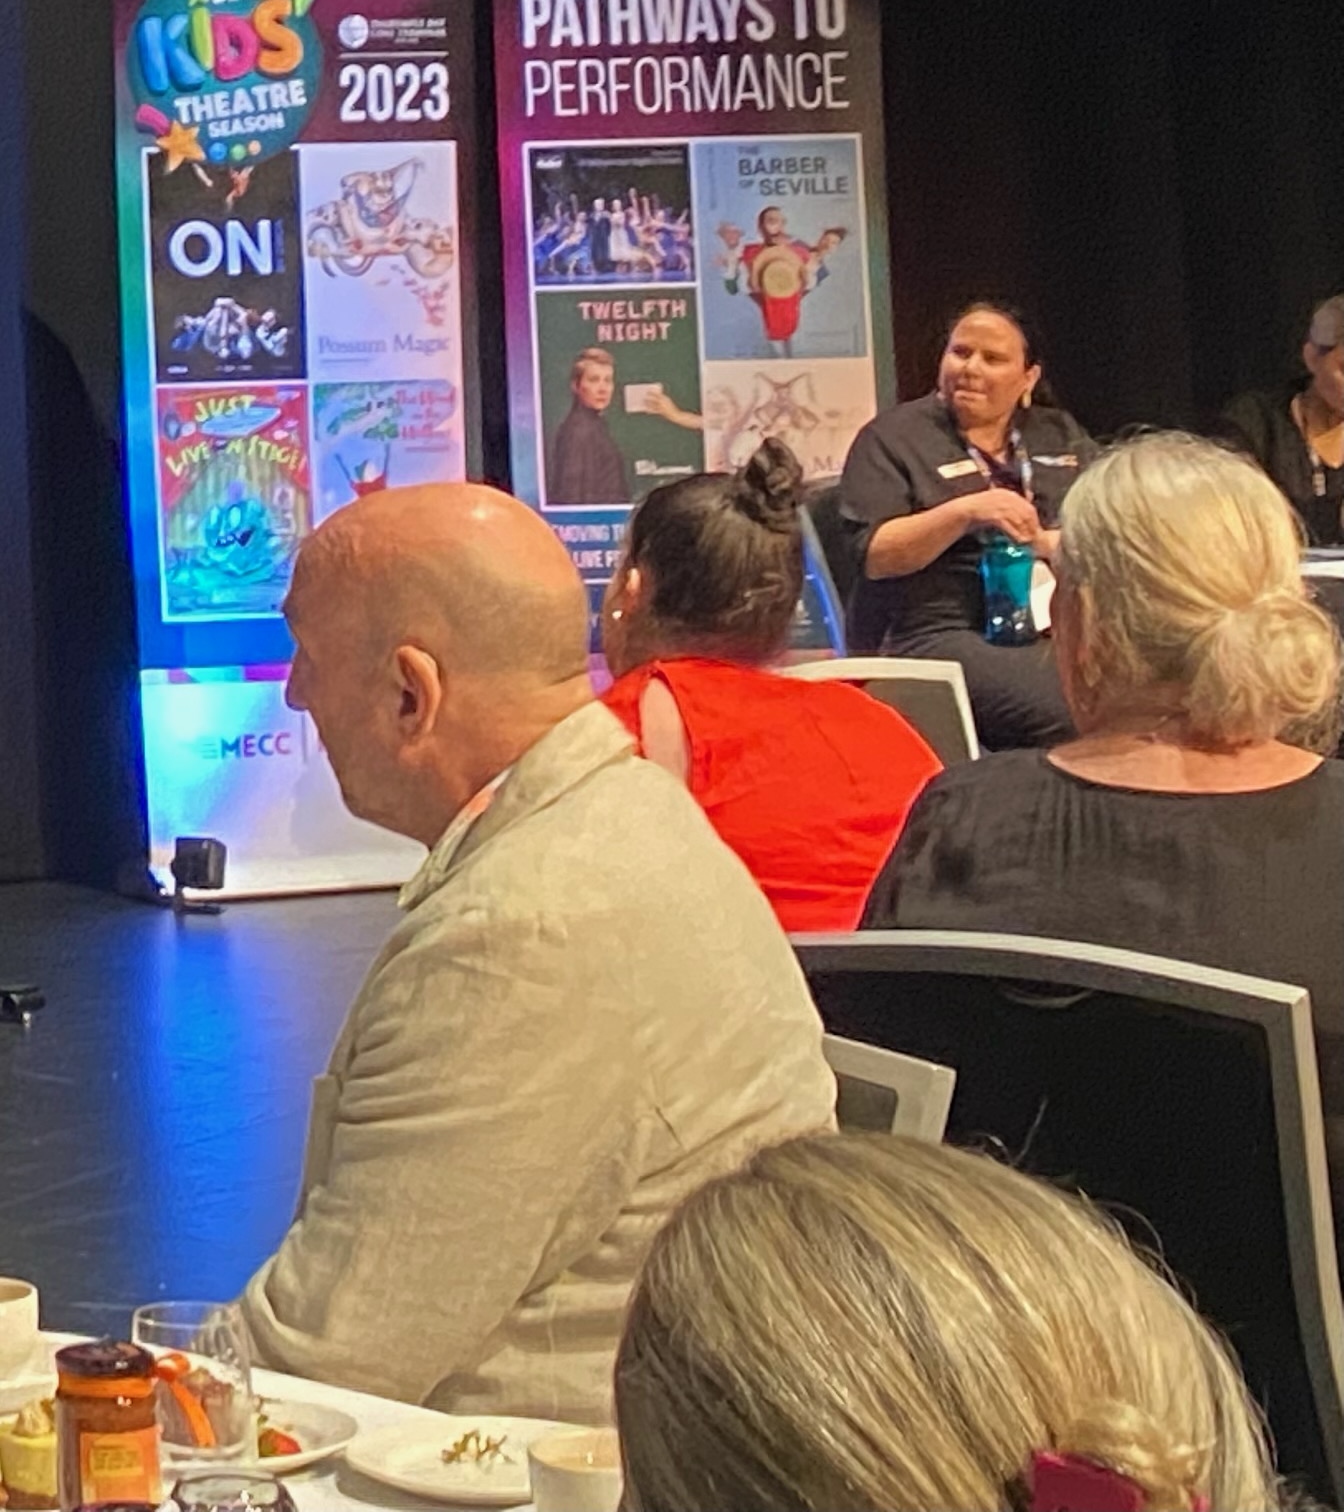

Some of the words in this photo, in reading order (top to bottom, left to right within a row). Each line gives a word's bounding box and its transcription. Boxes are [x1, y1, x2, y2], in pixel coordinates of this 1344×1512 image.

[338, 61, 451, 124] 2023
[523, 49, 851, 118] PERFORMANCE
[174, 78, 308, 125] THEATRE
[207, 111, 286, 139] SEASON
[737, 155, 827, 176] BARBER
[758, 175, 850, 196] SEVILLE
[168, 218, 274, 279] ON
[577, 299, 688, 322] TWELFTH
[596, 321, 672, 343] NIGHT
[194, 394, 257, 423] JUST
[165, 441, 211, 478] LIVE
[220, 731, 293, 760] MECC
